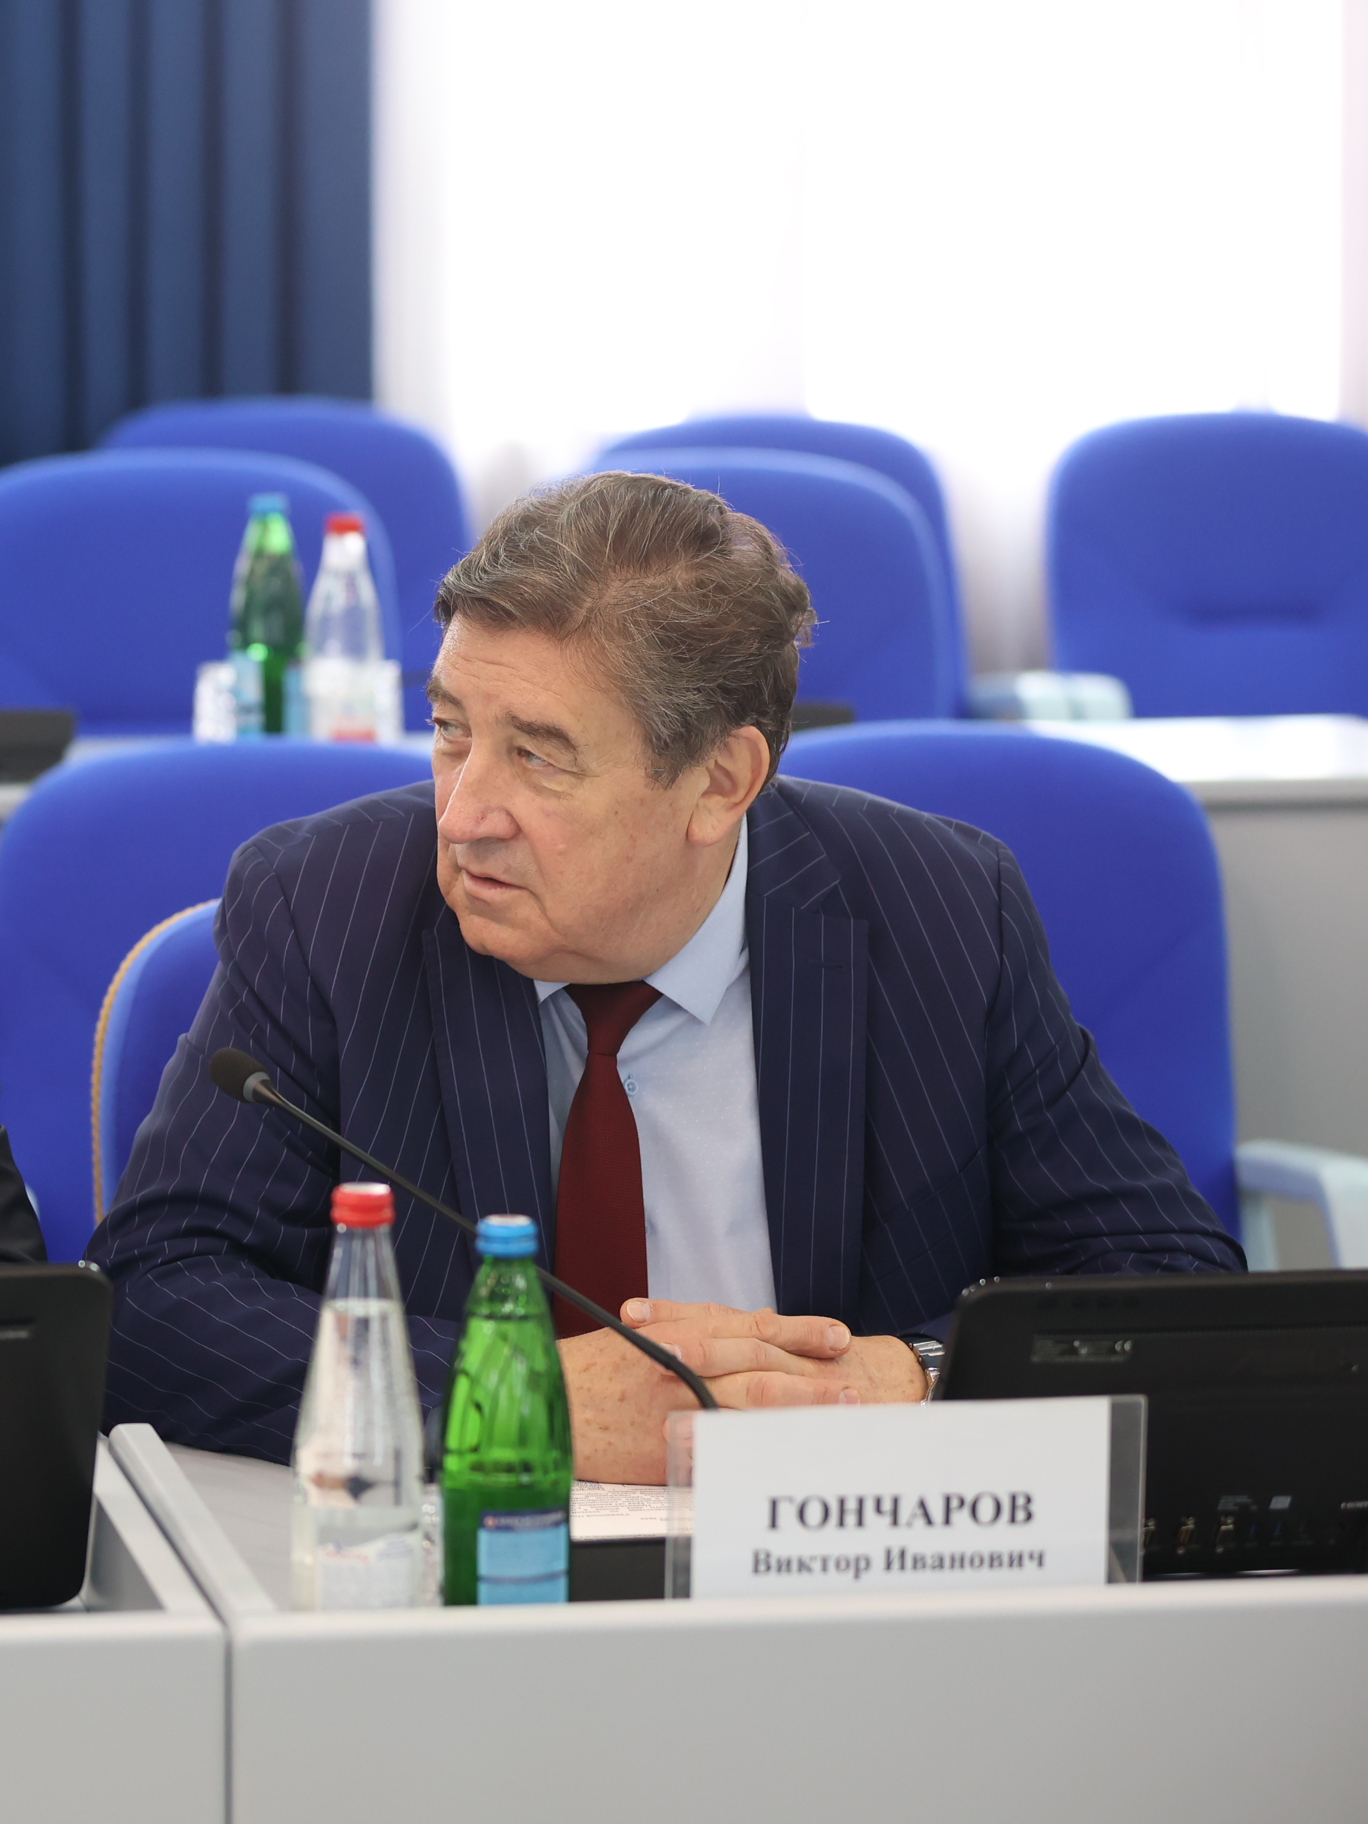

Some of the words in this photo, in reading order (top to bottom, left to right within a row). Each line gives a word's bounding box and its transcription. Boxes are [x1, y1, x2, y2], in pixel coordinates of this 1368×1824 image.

[768, 1491, 1035, 1531] ГОНЧАРОВ
[752, 1548, 872, 1582] Виктор
[883, 1546, 1045, 1573] Иванович
